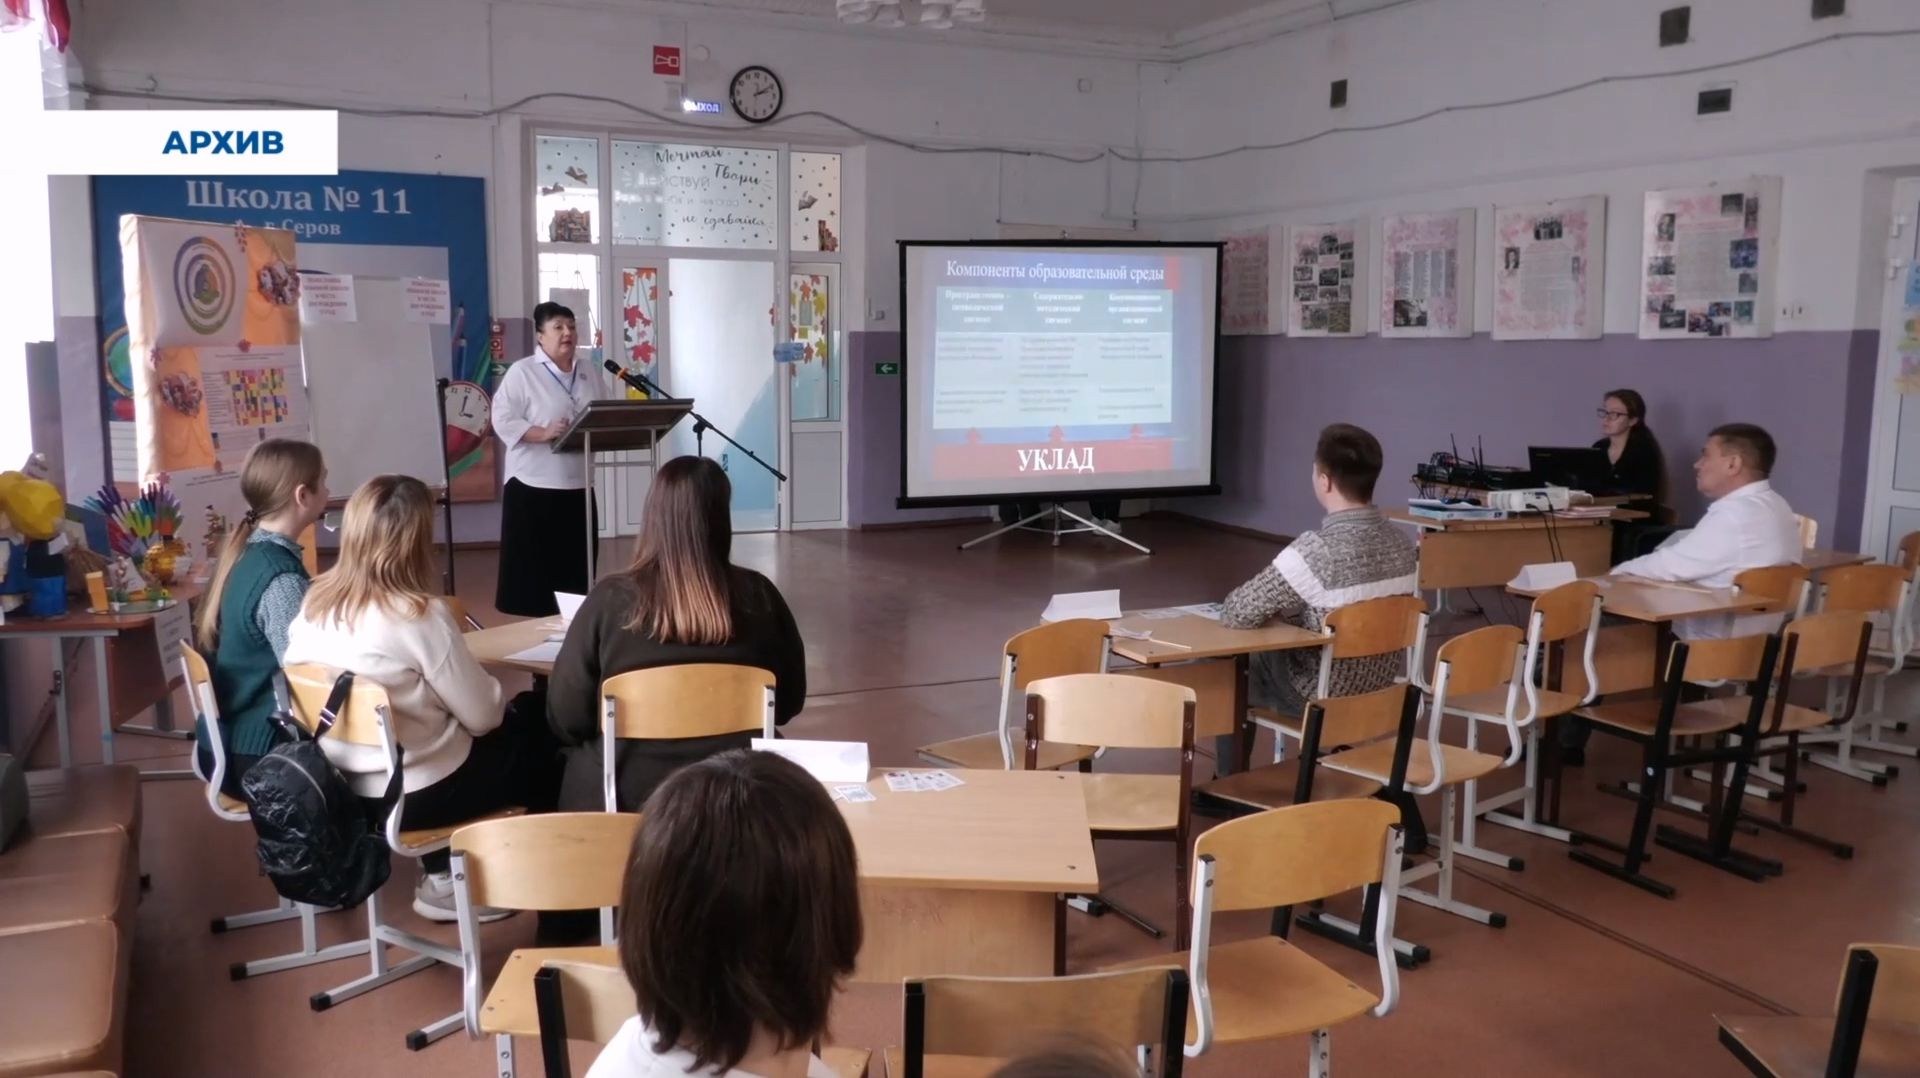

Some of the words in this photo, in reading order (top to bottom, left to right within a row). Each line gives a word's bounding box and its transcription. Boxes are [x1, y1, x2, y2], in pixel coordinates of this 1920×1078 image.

[655, 147, 724, 164] Мечтай
[713, 162, 761, 186] Твори
[185, 179, 313, 211] Школа
[322, 185, 361, 212] №
[371, 188, 412, 214] 11
[281, 218, 342, 239] Серов
[946, 260, 1026, 278] Компоненты
[1029, 263, 1128, 283] образовательной
[1130, 269, 1165, 286] среды
[1017, 447, 1095, 474] УКЛАД
